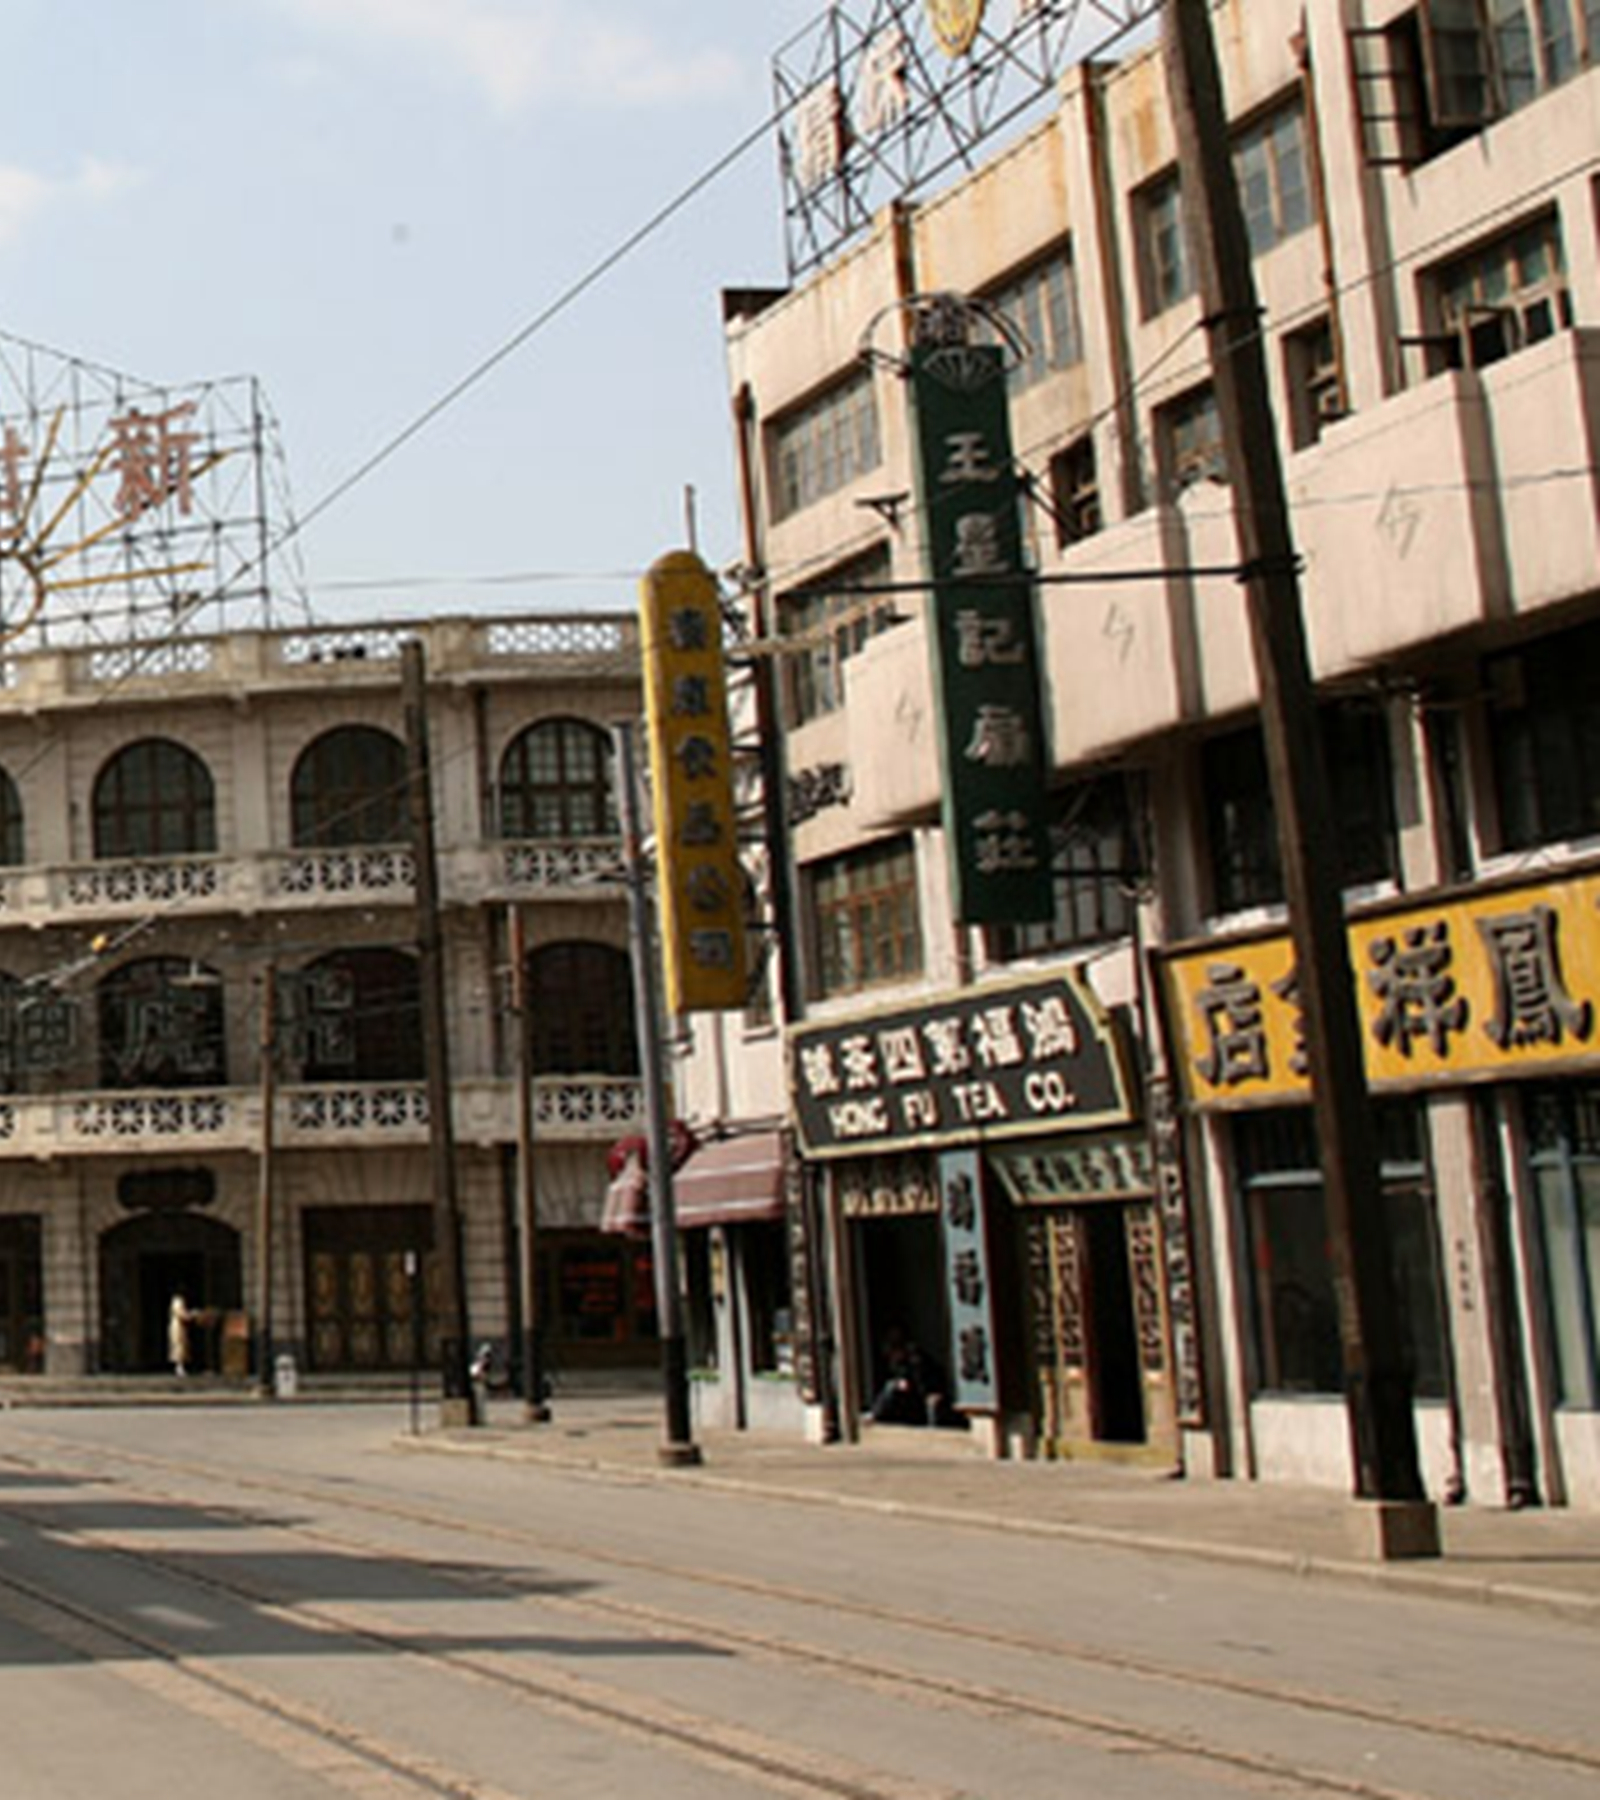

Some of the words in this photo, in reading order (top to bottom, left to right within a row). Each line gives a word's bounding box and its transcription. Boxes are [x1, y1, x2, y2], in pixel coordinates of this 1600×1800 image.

[1195, 897, 1600, 1087] 鳳祥店
[903, 1090, 939, 1129] FU
[953, 1081, 1009, 1120] TEA
[1025, 1069, 1076, 1111] CO.
